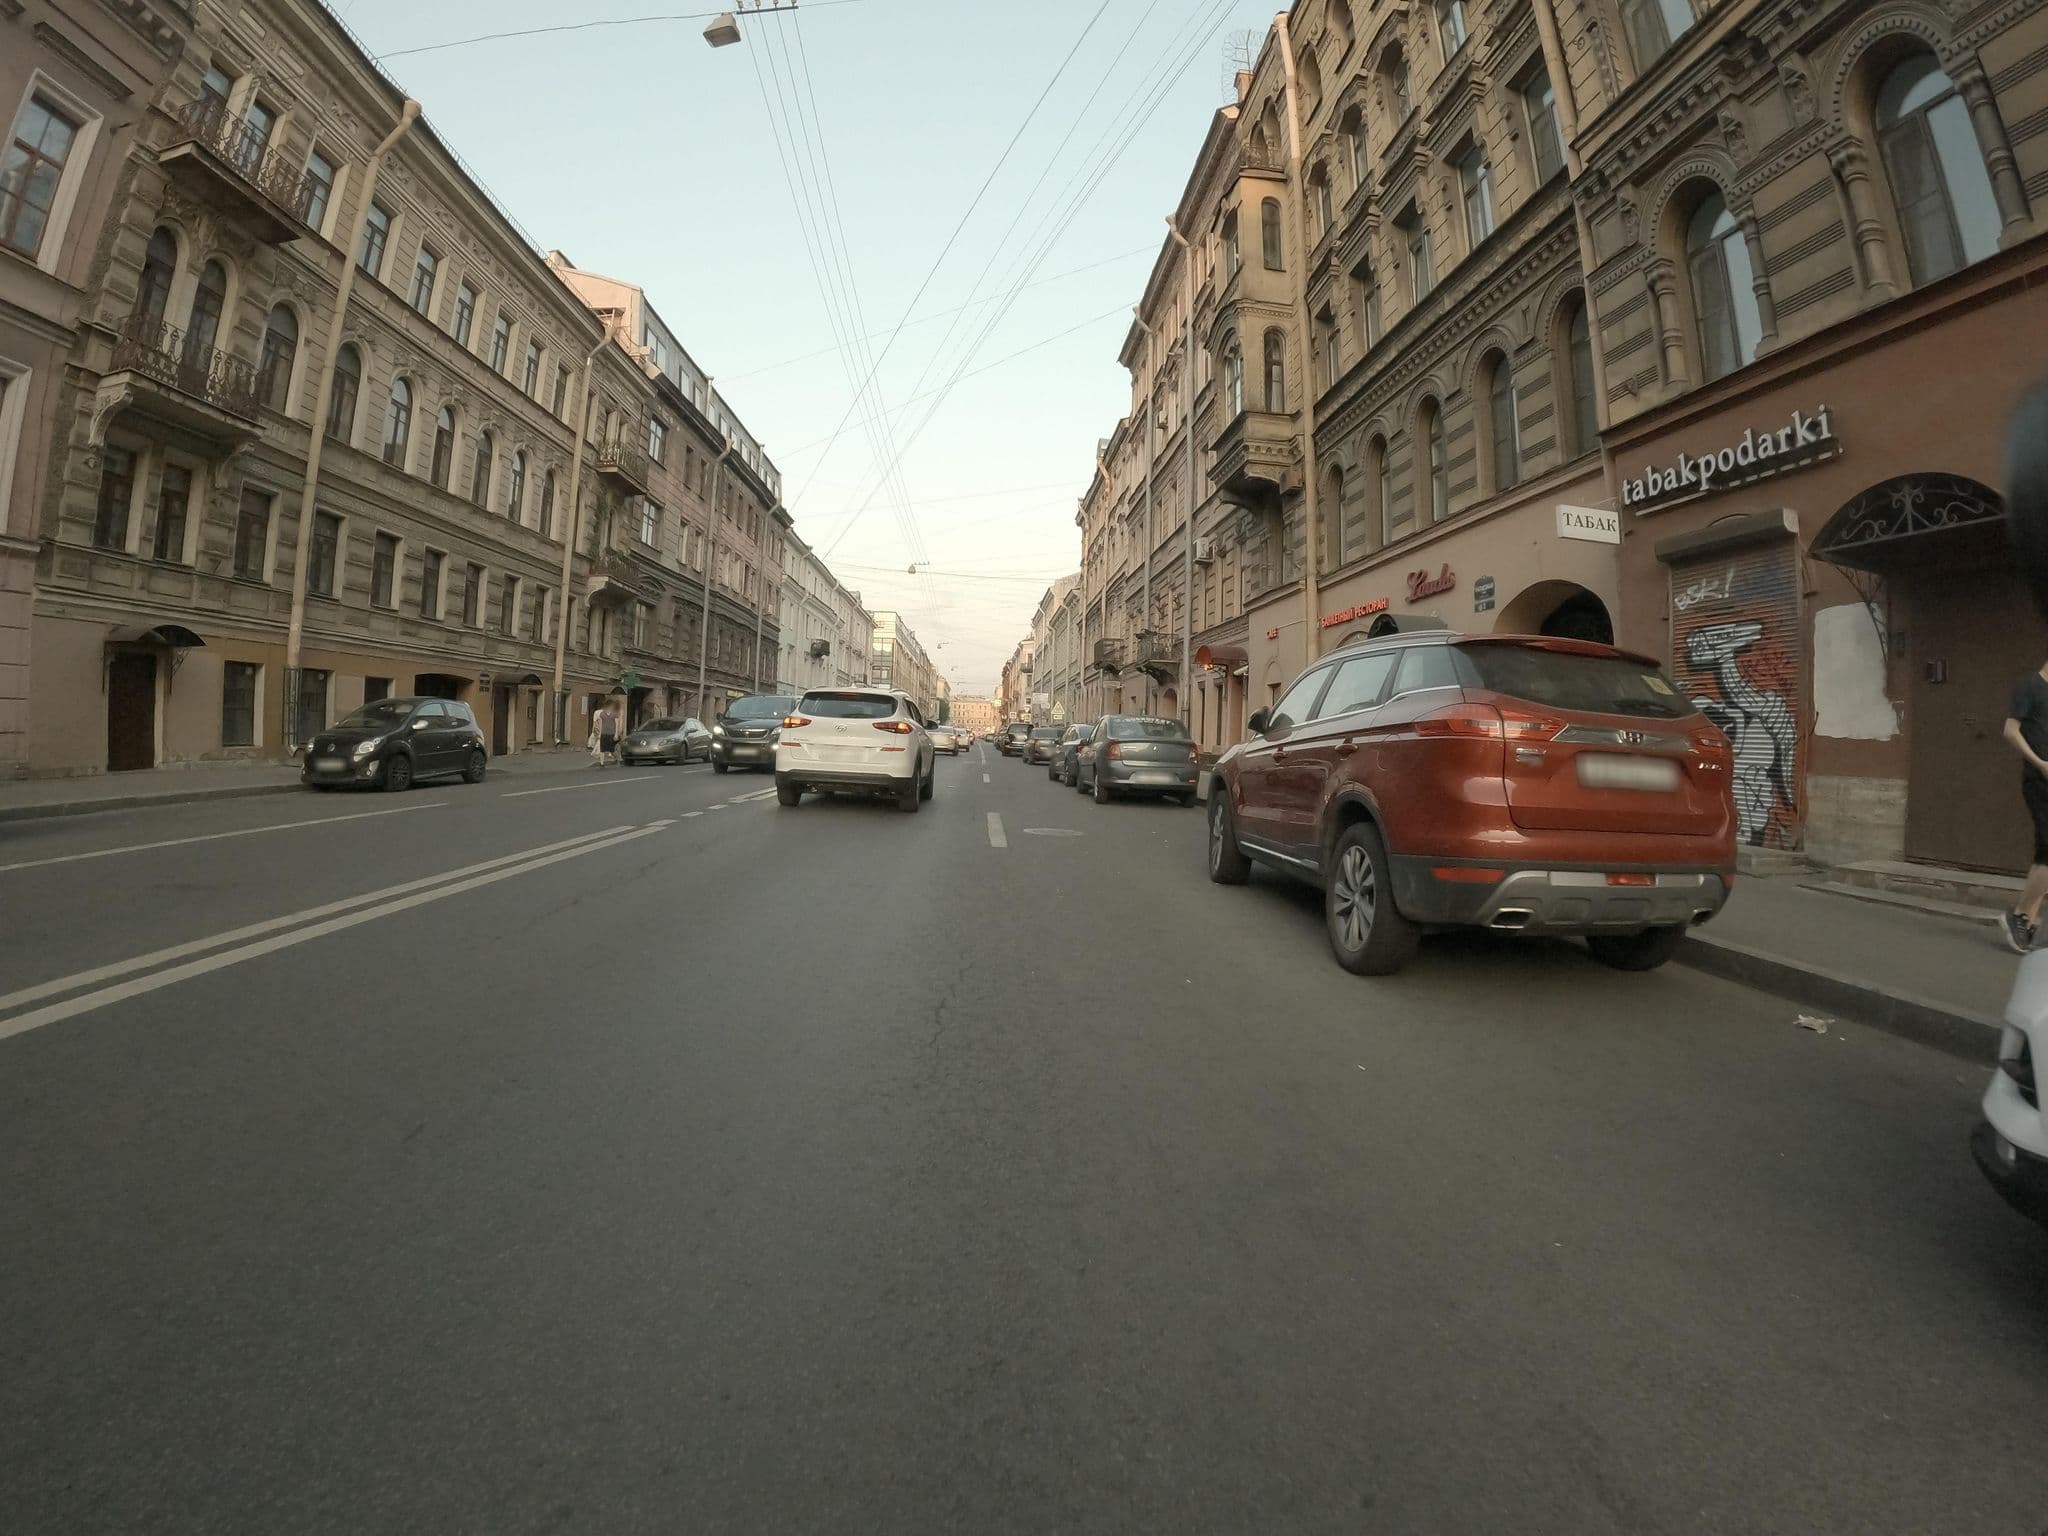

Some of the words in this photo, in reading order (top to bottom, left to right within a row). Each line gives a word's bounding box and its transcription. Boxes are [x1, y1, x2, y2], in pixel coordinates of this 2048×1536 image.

[1622, 404, 1832, 505] tabakpodarki
[1562, 512, 1617, 532] ТАБАК
[1354, 597, 1389, 617] РЕСТОРАН
